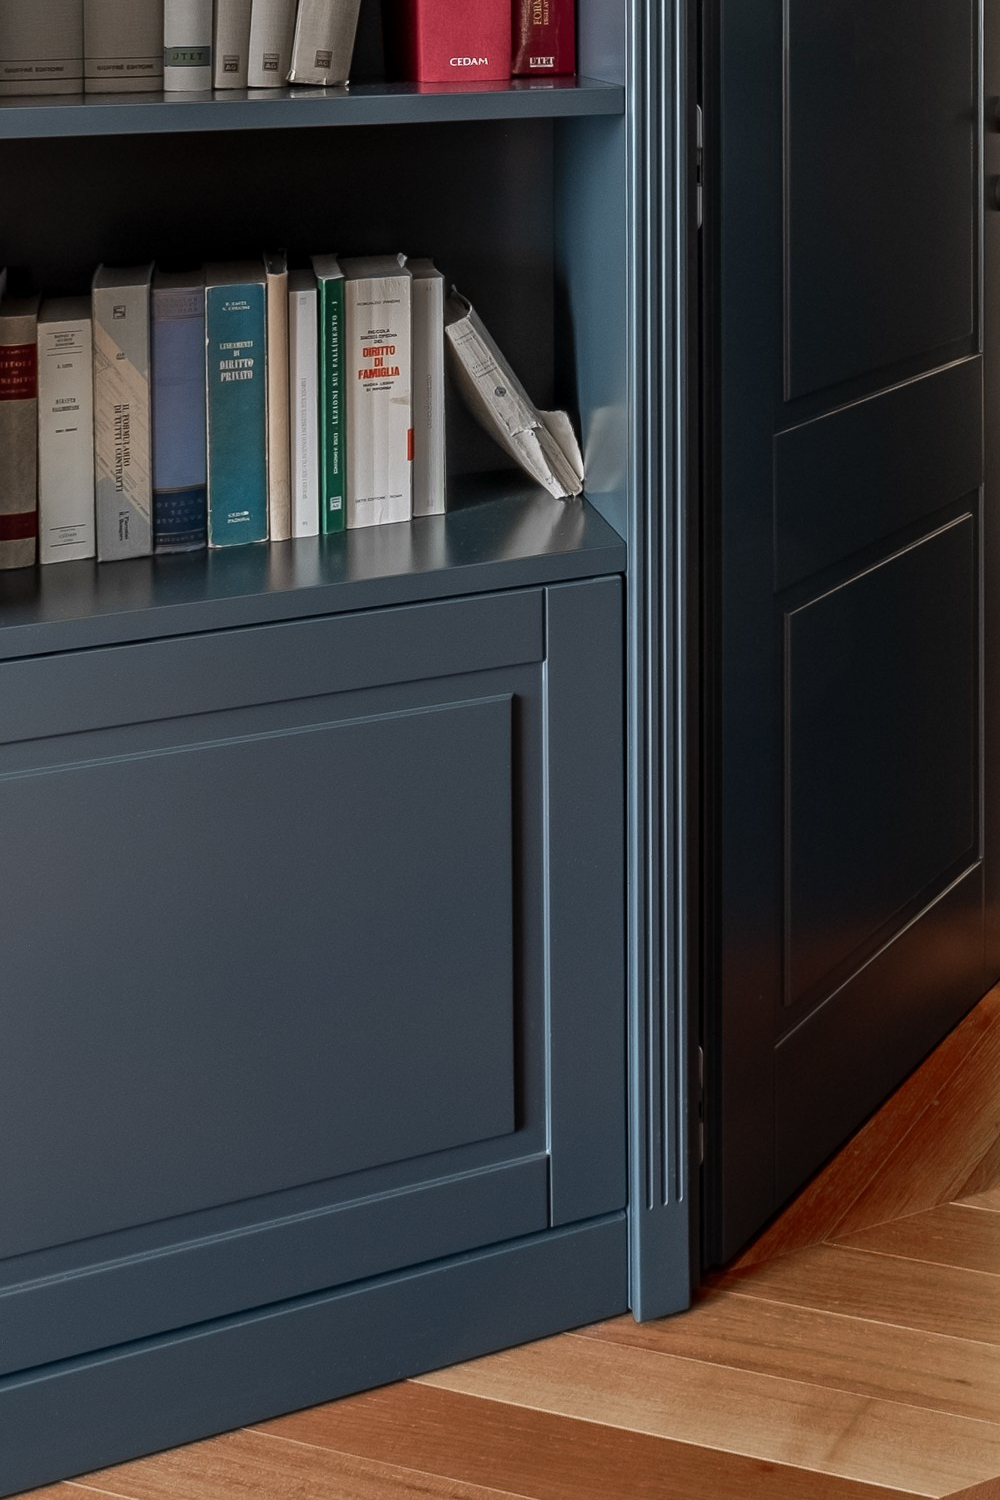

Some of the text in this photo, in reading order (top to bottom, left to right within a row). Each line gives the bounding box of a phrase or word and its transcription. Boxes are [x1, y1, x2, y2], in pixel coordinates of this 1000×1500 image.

[450, 57, 488, 66] CEDAM
[530, 57, 554, 65] UTET
[363, 345, 396, 357] DIRITTO
[220, 359, 254, 370] DIRITTO
[374, 357, 383, 367] DI
[221, 370, 253, 382] PRIVATO
[358, 366, 400, 380] FAMIGLIA
